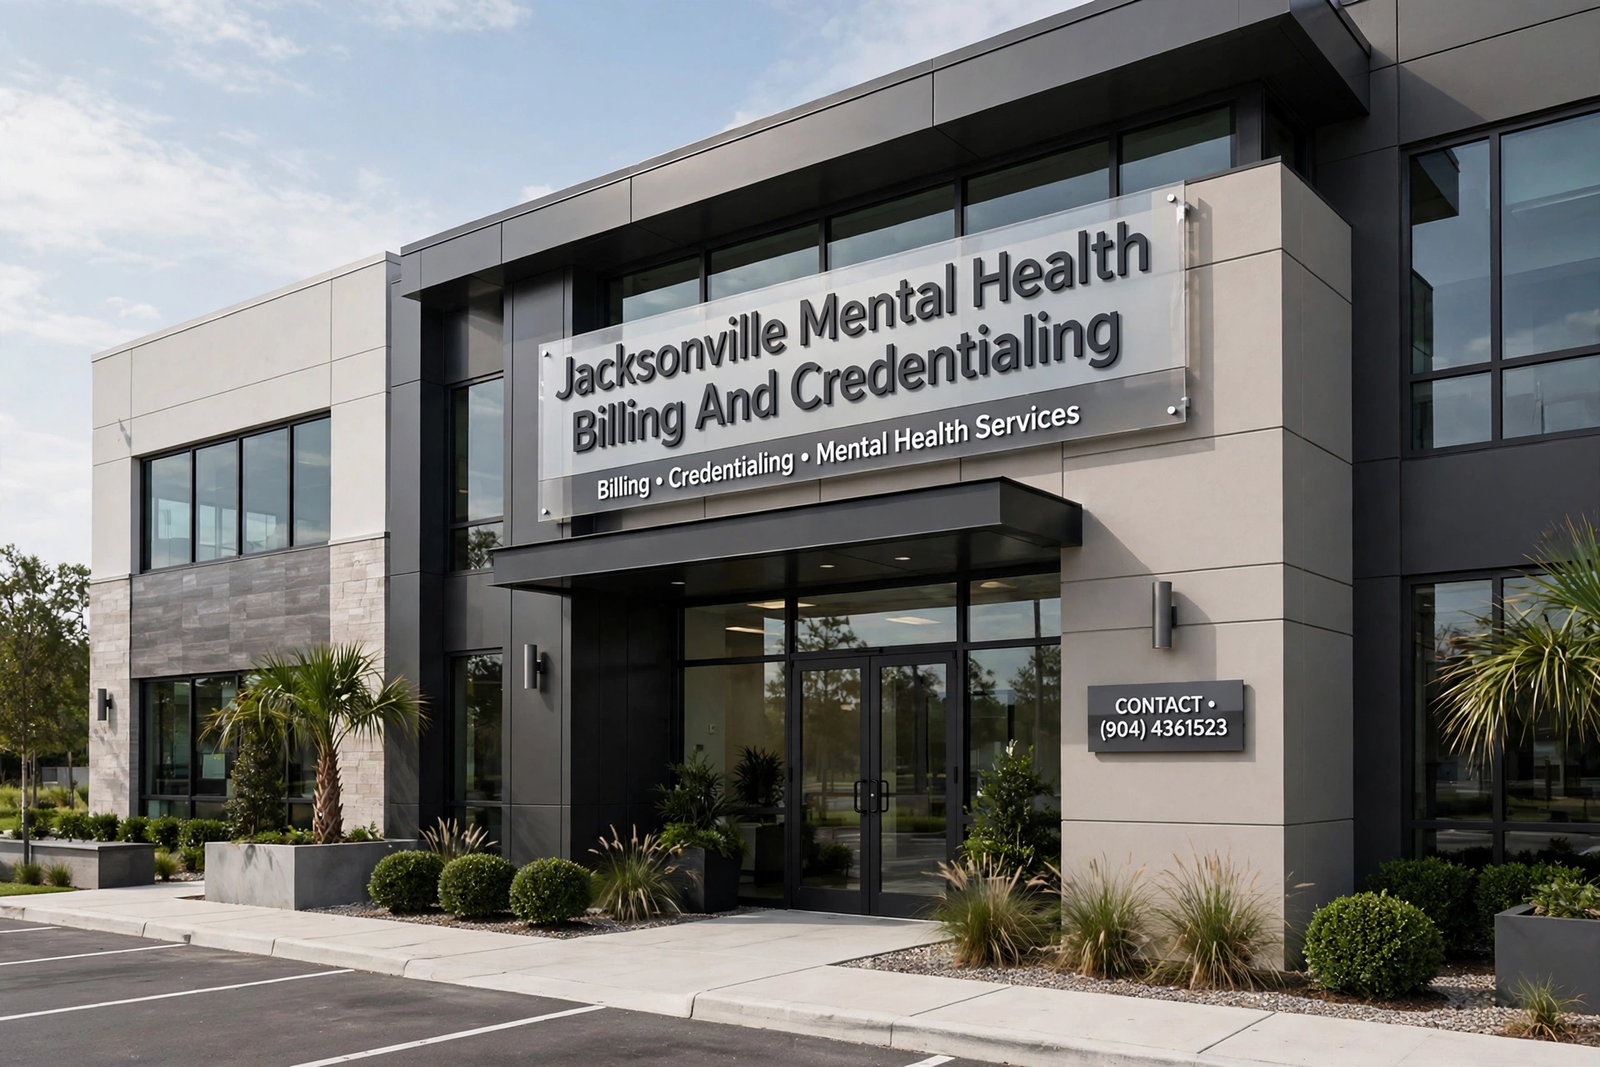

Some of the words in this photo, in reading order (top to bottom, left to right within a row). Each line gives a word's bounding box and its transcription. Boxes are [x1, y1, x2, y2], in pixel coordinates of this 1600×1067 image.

[556, 310, 787, 401] Jacksonville
[800, 262, 957, 347] Mental
[973, 220, 1151, 310] Health
[572, 399, 686, 452] Billing
[695, 368, 778, 430] And
[791, 310, 1123, 412] Credentialing
[597, 475, 650, 500] Billing
[668, 451, 794, 488] Credentialing
[815, 431, 887, 465] Mental
[894, 418, 968, 453] Health
[975, 405, 1081, 439] Services
[1100, 719, 1146, 741] (904)
[1150, 718, 1228, 737] 4361523
[1115, 695, 1203, 715] CONTACT
